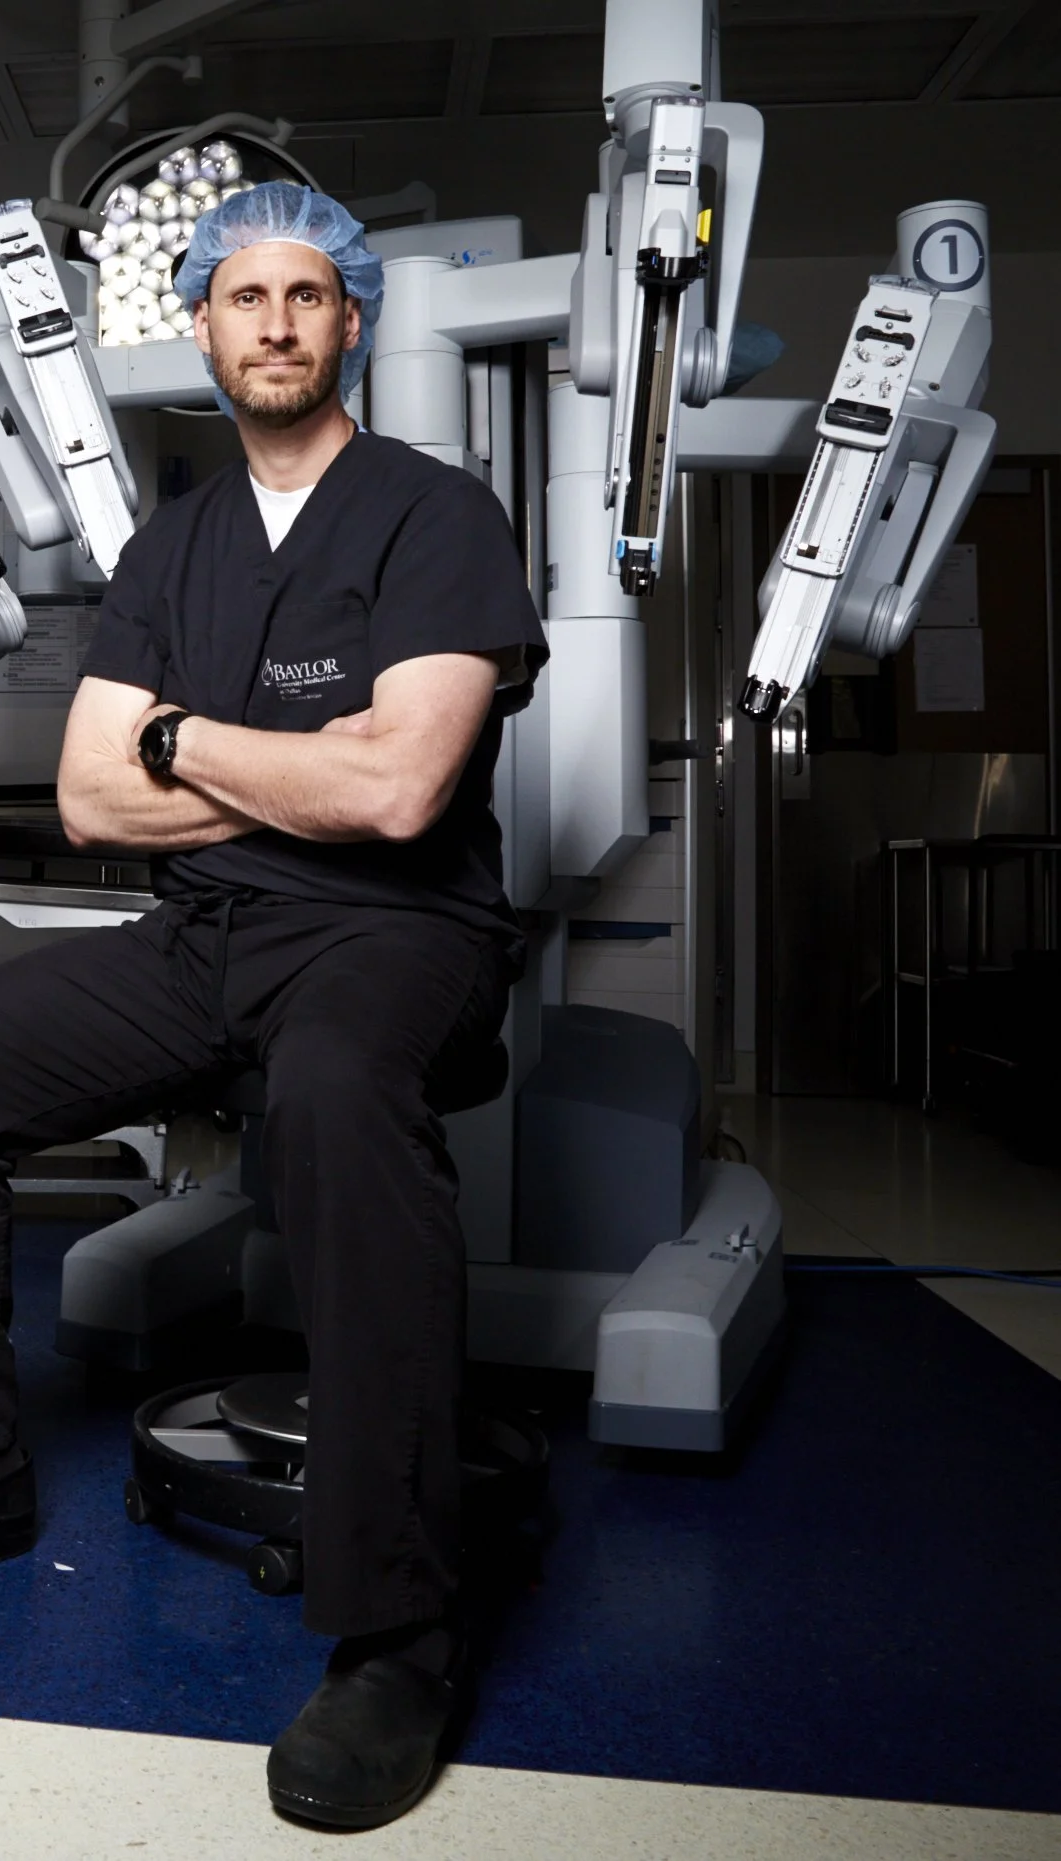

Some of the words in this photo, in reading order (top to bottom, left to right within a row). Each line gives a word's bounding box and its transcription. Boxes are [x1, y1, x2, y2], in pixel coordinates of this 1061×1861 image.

[940, 234, 959, 275] 1
[273, 658, 339, 681] BAYLOR
[303, 676, 327, 685] Medical
[326, 673, 346, 681] Center
